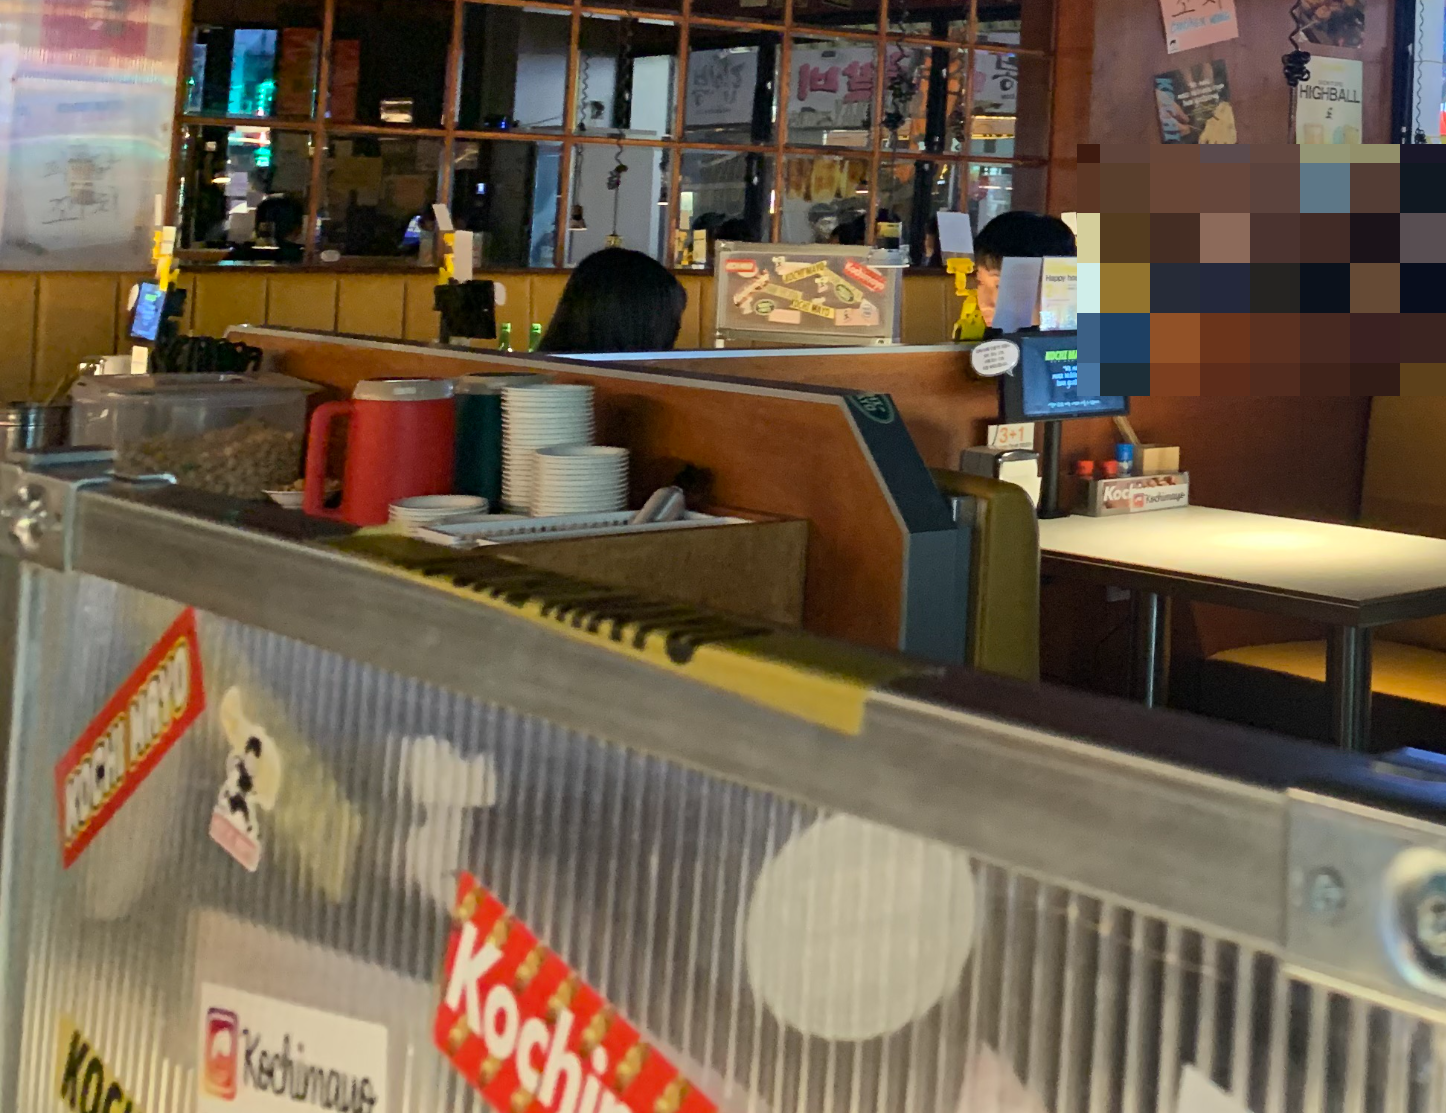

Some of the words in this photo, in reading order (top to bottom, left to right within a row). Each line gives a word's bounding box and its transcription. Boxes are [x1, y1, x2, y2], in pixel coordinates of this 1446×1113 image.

[1299, 86, 1361, 104] HIGHBALL
[998, 426, 1026, 445] 3+1
[445, 920, 634, 1113] Kochi
[60, 1025, 130, 1113] KOC
